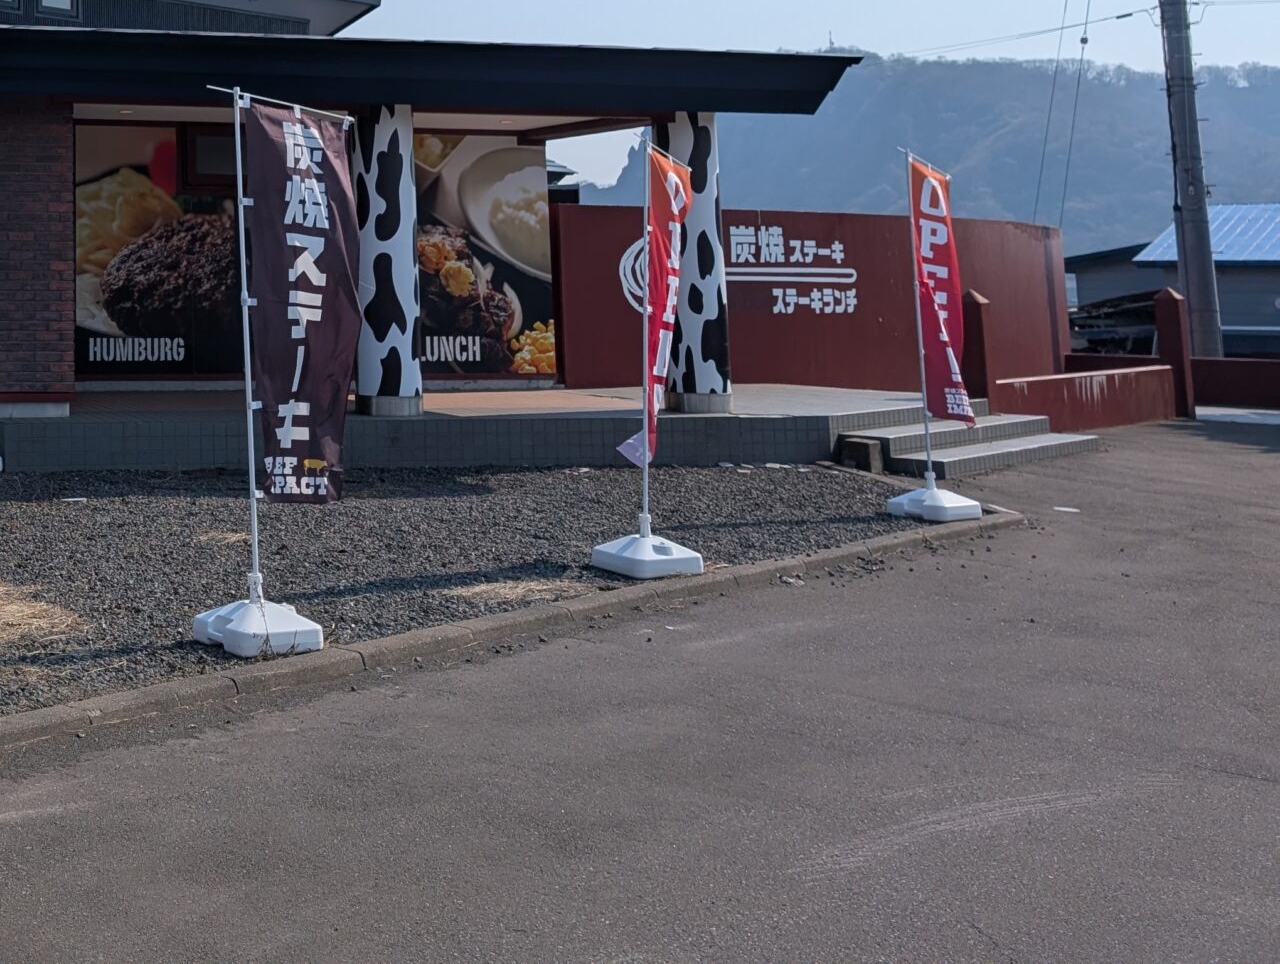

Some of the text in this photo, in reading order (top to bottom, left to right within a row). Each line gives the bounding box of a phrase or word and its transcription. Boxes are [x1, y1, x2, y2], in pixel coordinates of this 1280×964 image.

[275, 121, 330, 449] 炭焼ステーキ
[772, 287, 858, 314] ステーキランチ
[89, 337, 185, 362] HUMBURG
[421, 335, 481, 362] UNCH
[271, 475, 328, 496] PACT
